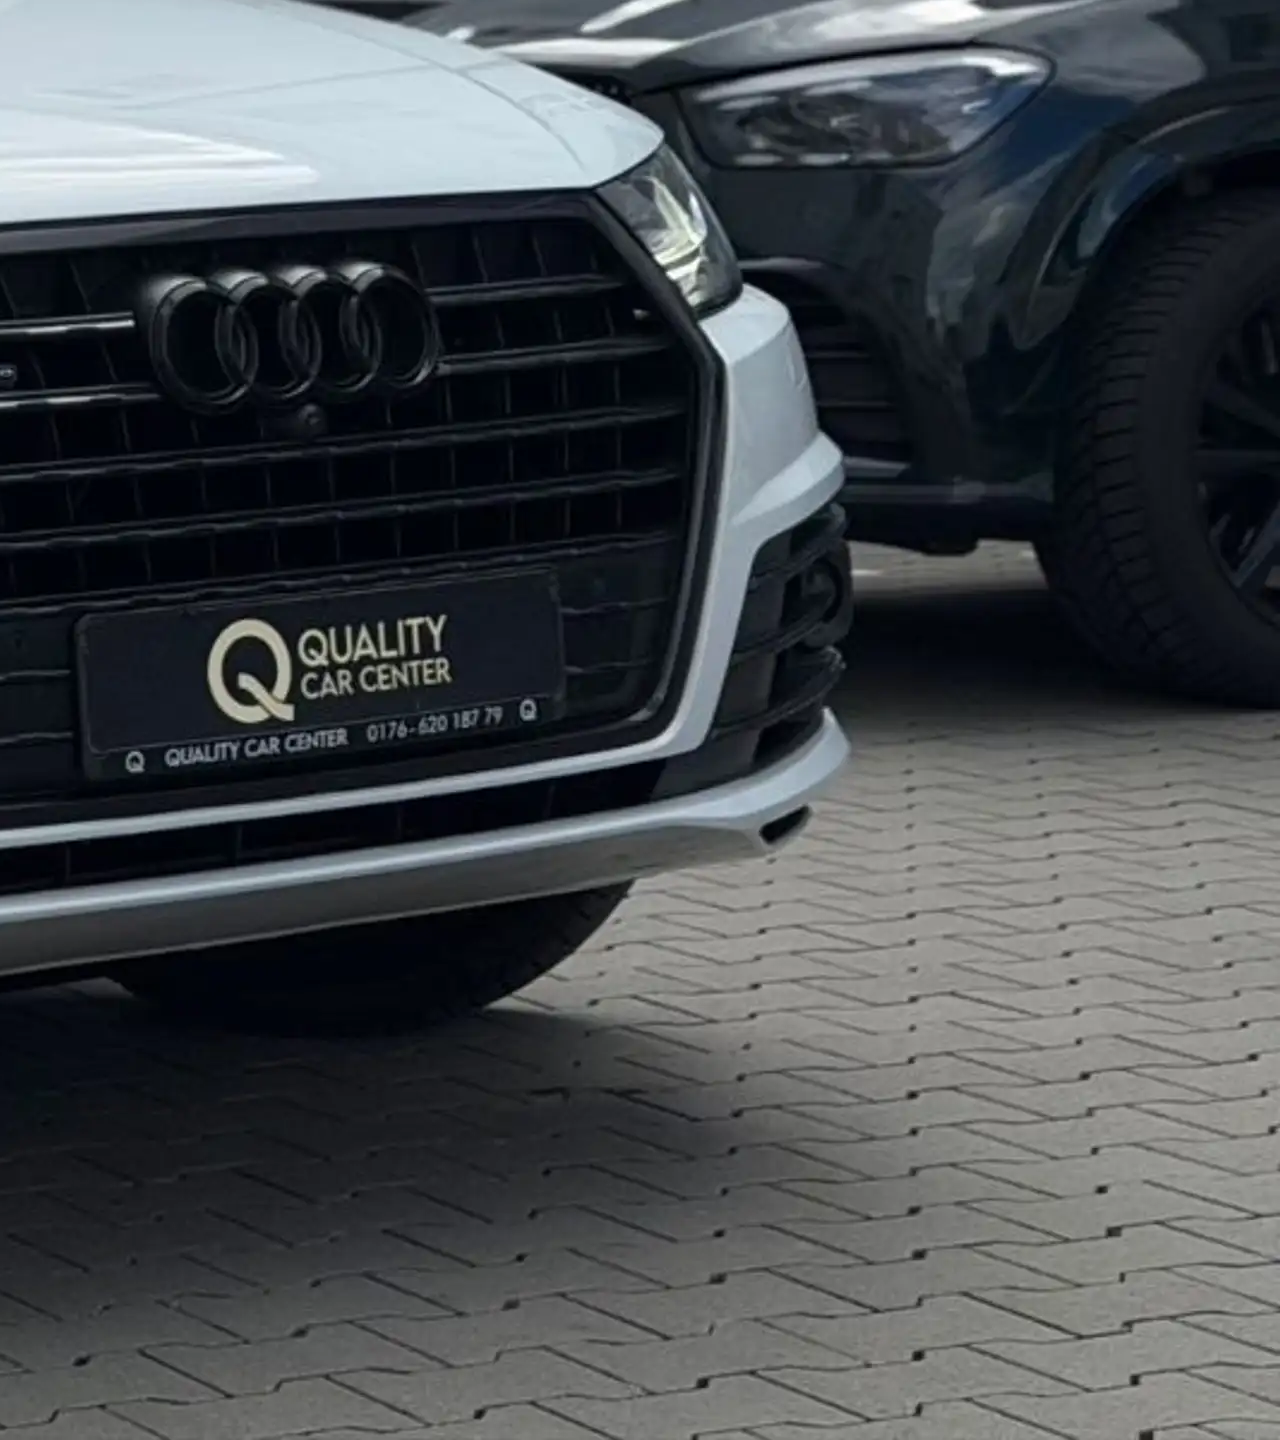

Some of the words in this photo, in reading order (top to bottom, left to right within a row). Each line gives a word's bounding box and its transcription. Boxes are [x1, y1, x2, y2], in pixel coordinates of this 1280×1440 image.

[297, 614, 448, 667] QUALITY
[300, 668, 355, 700] CAR
[358, 657, 453, 693] CENTER
[164, 741, 240, 768] QUALITY
[244, 736, 281, 758] CAR
[284, 727, 349, 754] CENTER
[453, 709, 481, 730] 187
[484, 706, 504, 725] 79
